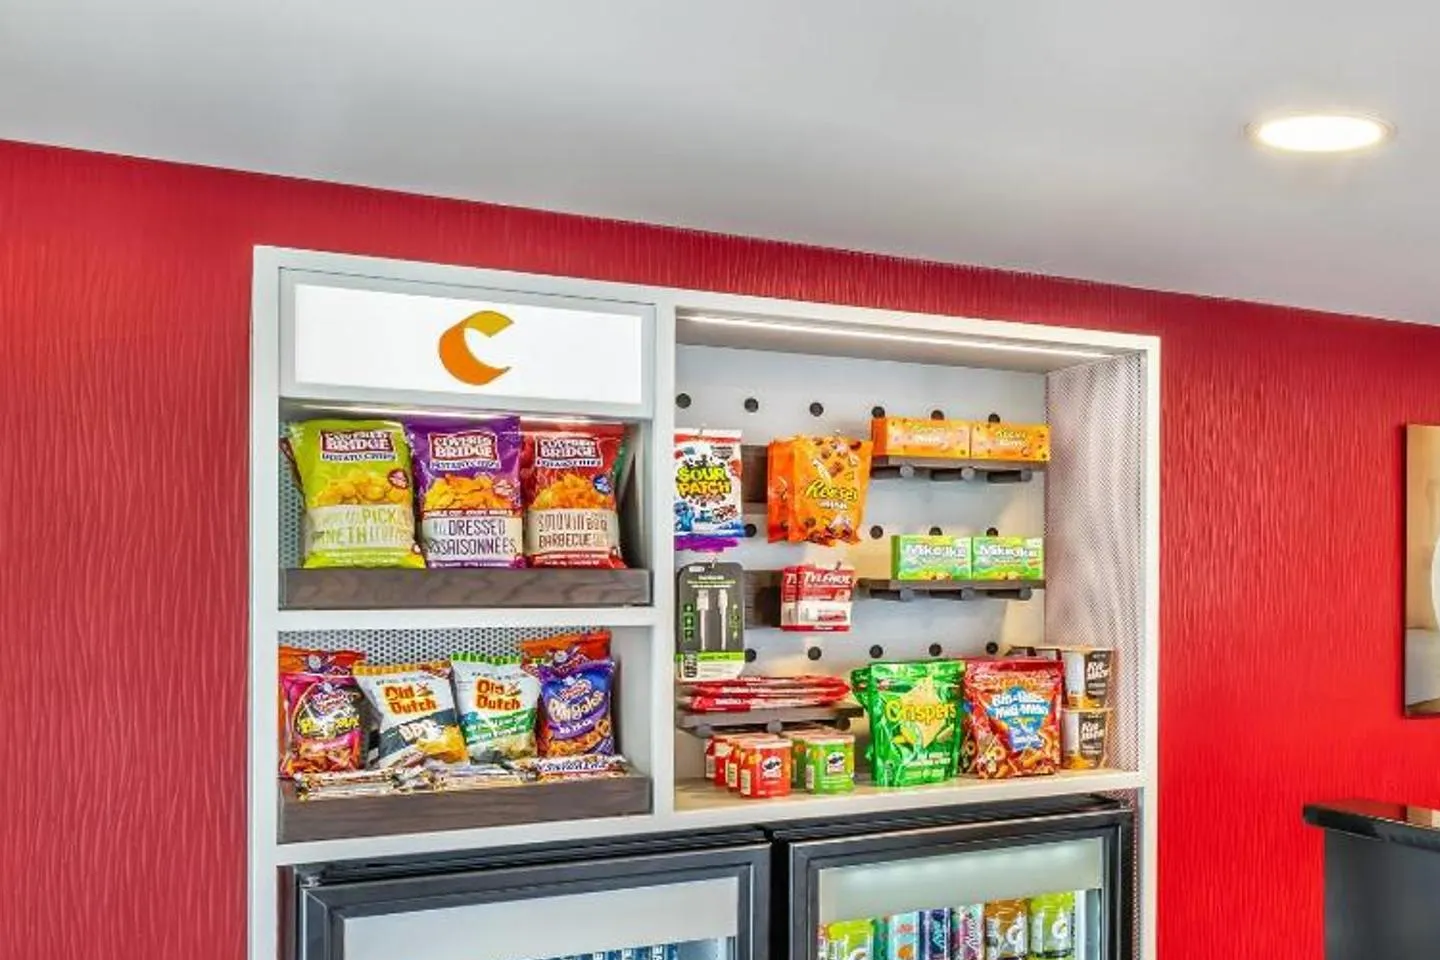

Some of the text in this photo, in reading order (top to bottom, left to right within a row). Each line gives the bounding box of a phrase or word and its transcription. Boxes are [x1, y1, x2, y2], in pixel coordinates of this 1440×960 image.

[324, 439, 391, 451] BRIDGE
[434, 446, 493, 458] BRIDGE
[541, 447, 597, 458] BRIDGE
[677, 466, 726, 483] SOUR
[677, 481, 731, 497] PATCH
[448, 519, 505, 537] DRESSED
[803, 570, 852, 585] TYLENOL
[476, 678, 505, 695] Old
[388, 698, 437, 715] Dutch
[475, 693, 521, 711] Dutch
[885, 699, 957, 725] Crispers
